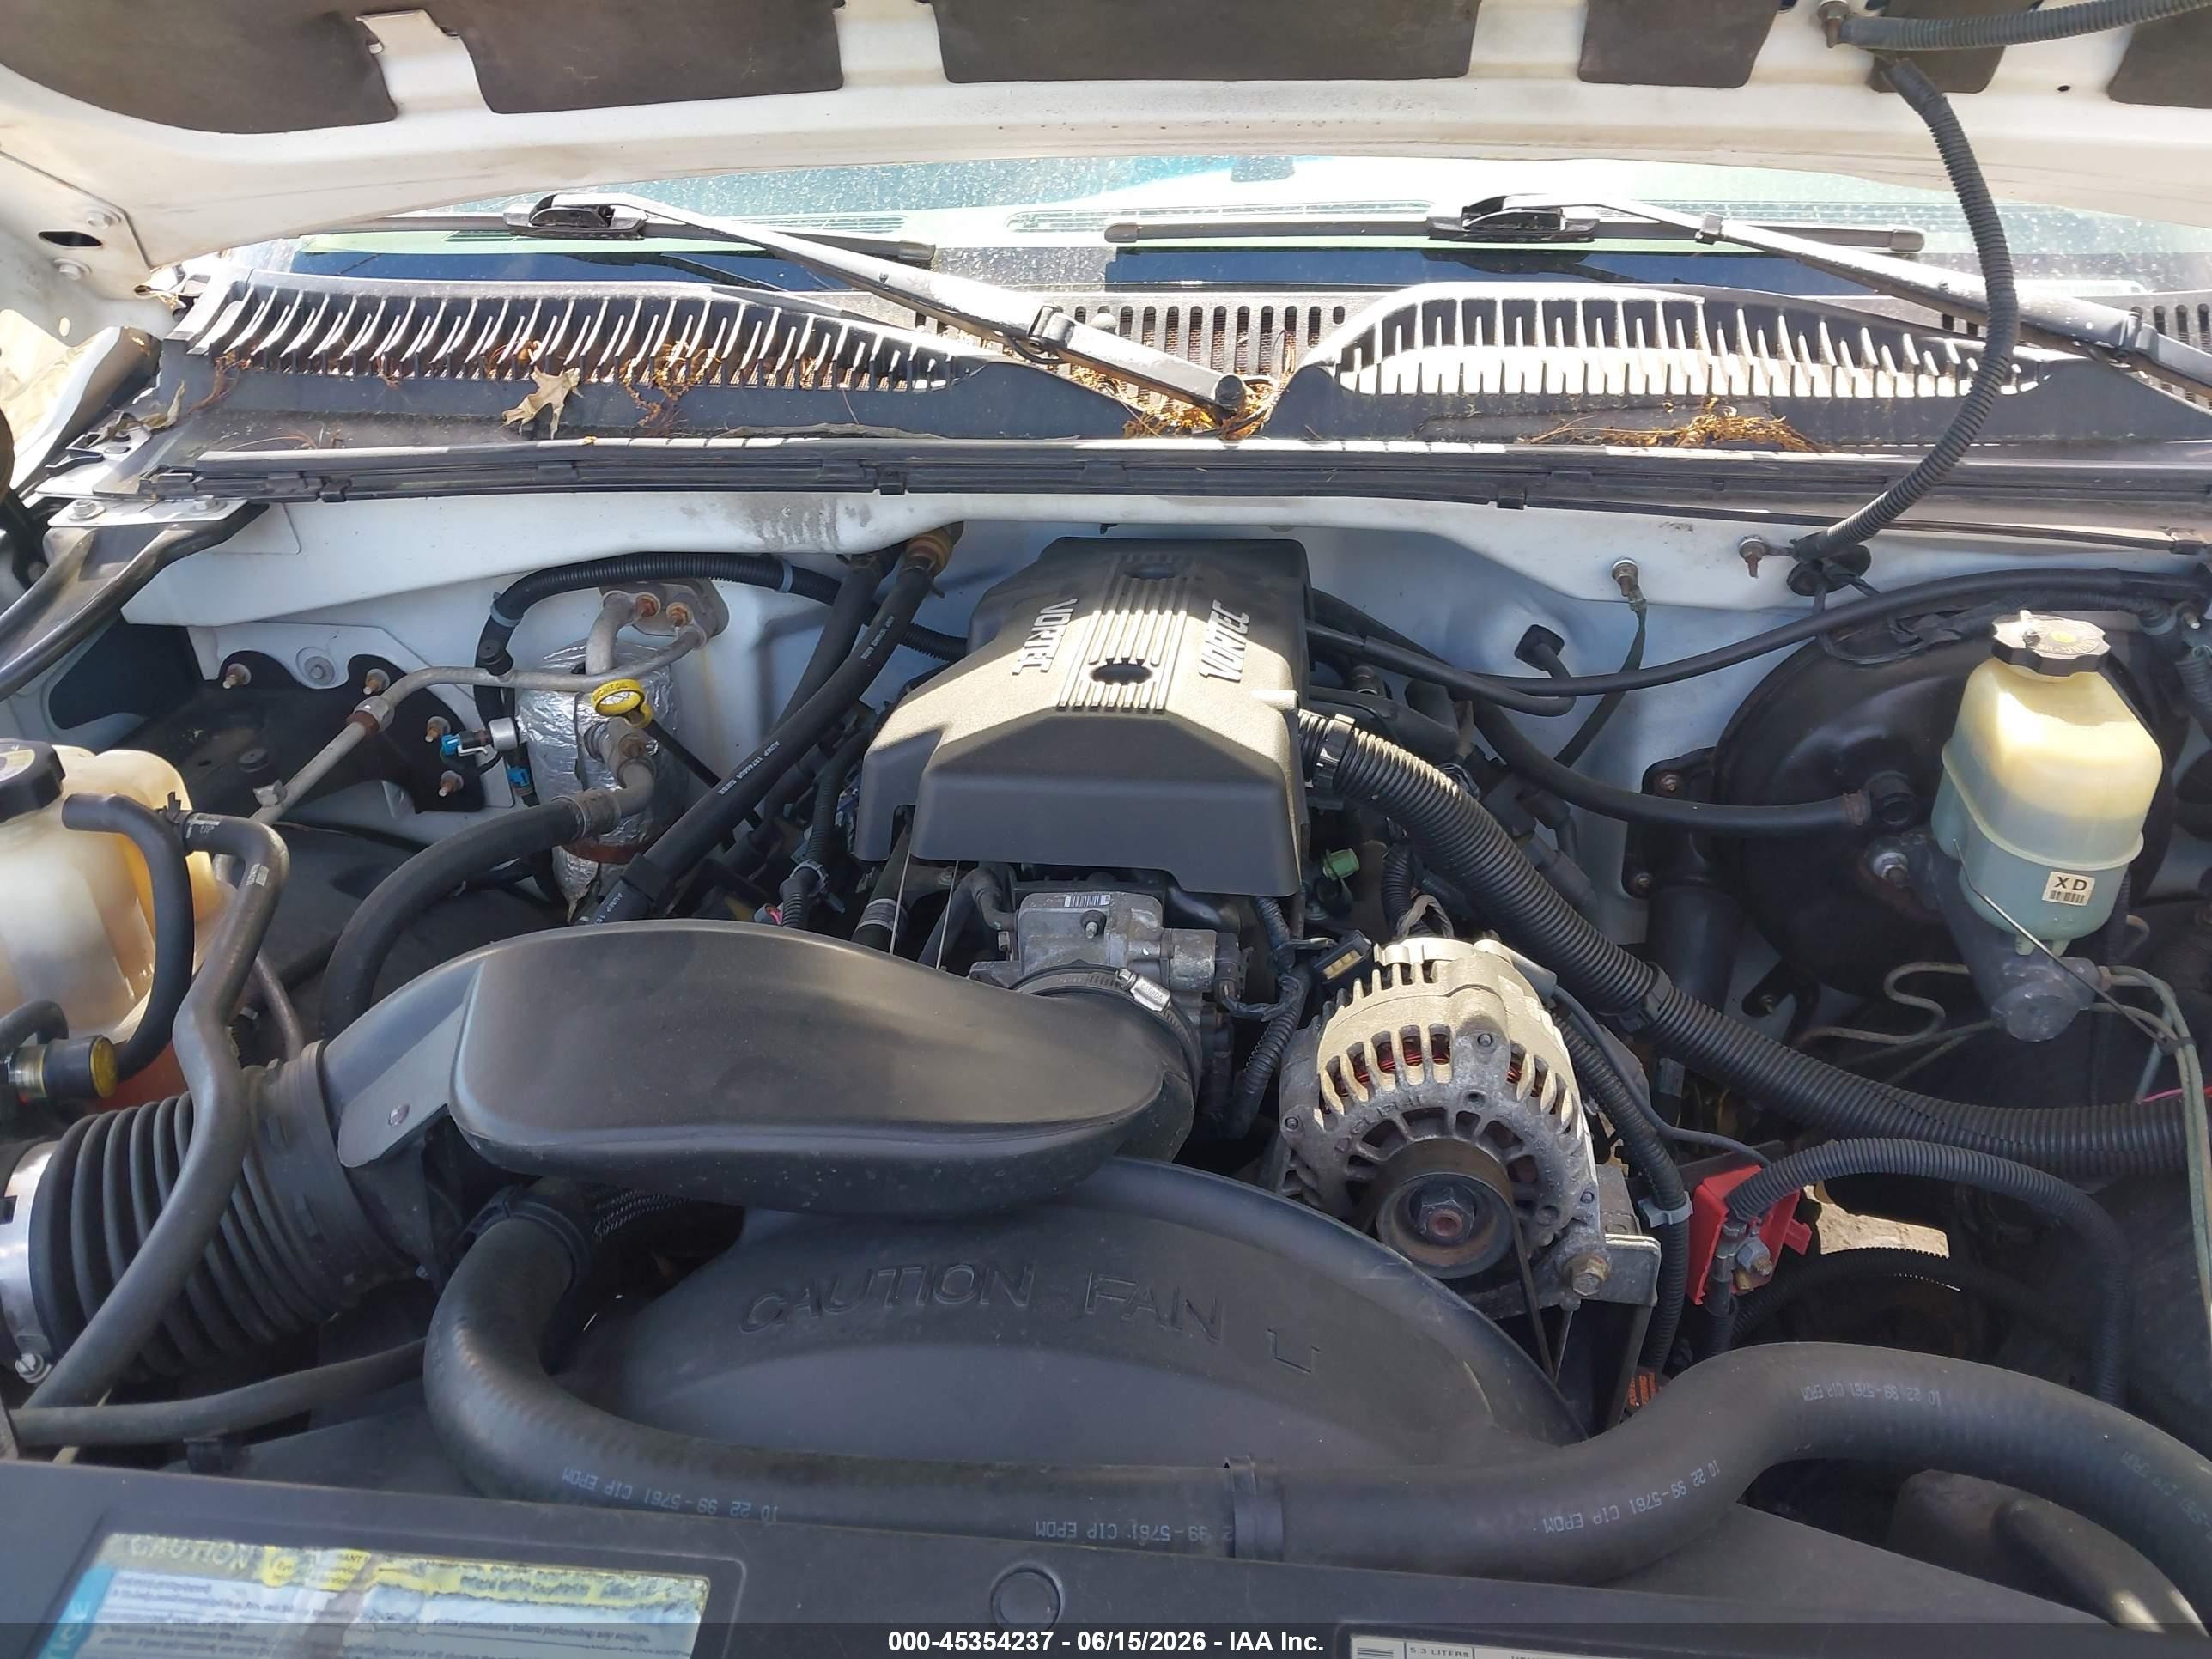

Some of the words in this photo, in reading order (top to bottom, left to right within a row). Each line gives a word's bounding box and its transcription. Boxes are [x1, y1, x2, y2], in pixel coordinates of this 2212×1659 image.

[1012, 598, 1079, 676] VORTEC
[1198, 599, 1250, 683] VORTEC
[738, 1263, 1036, 1334] CAUTION
[1085, 1269, 1224, 1345] FAN
[1690, 1468, 1706, 1487] 22
[1708, 1460, 1721, 1478] 10
[561, 1467, 599, 1492] EPDM
[604, 1480, 634, 1500] CIP
[730, 1500, 753, 1518] 22
[760, 1504, 780, 1523] 10
[1593, 1504, 1620, 1525] CIP
[1035, 1520, 1078, 1540] EPDM
[1086, 1522, 1119, 1540] CIP
[1543, 1514, 1584, 1534] EPDM
[1431, 1649, 1469, 1658] LITERS
